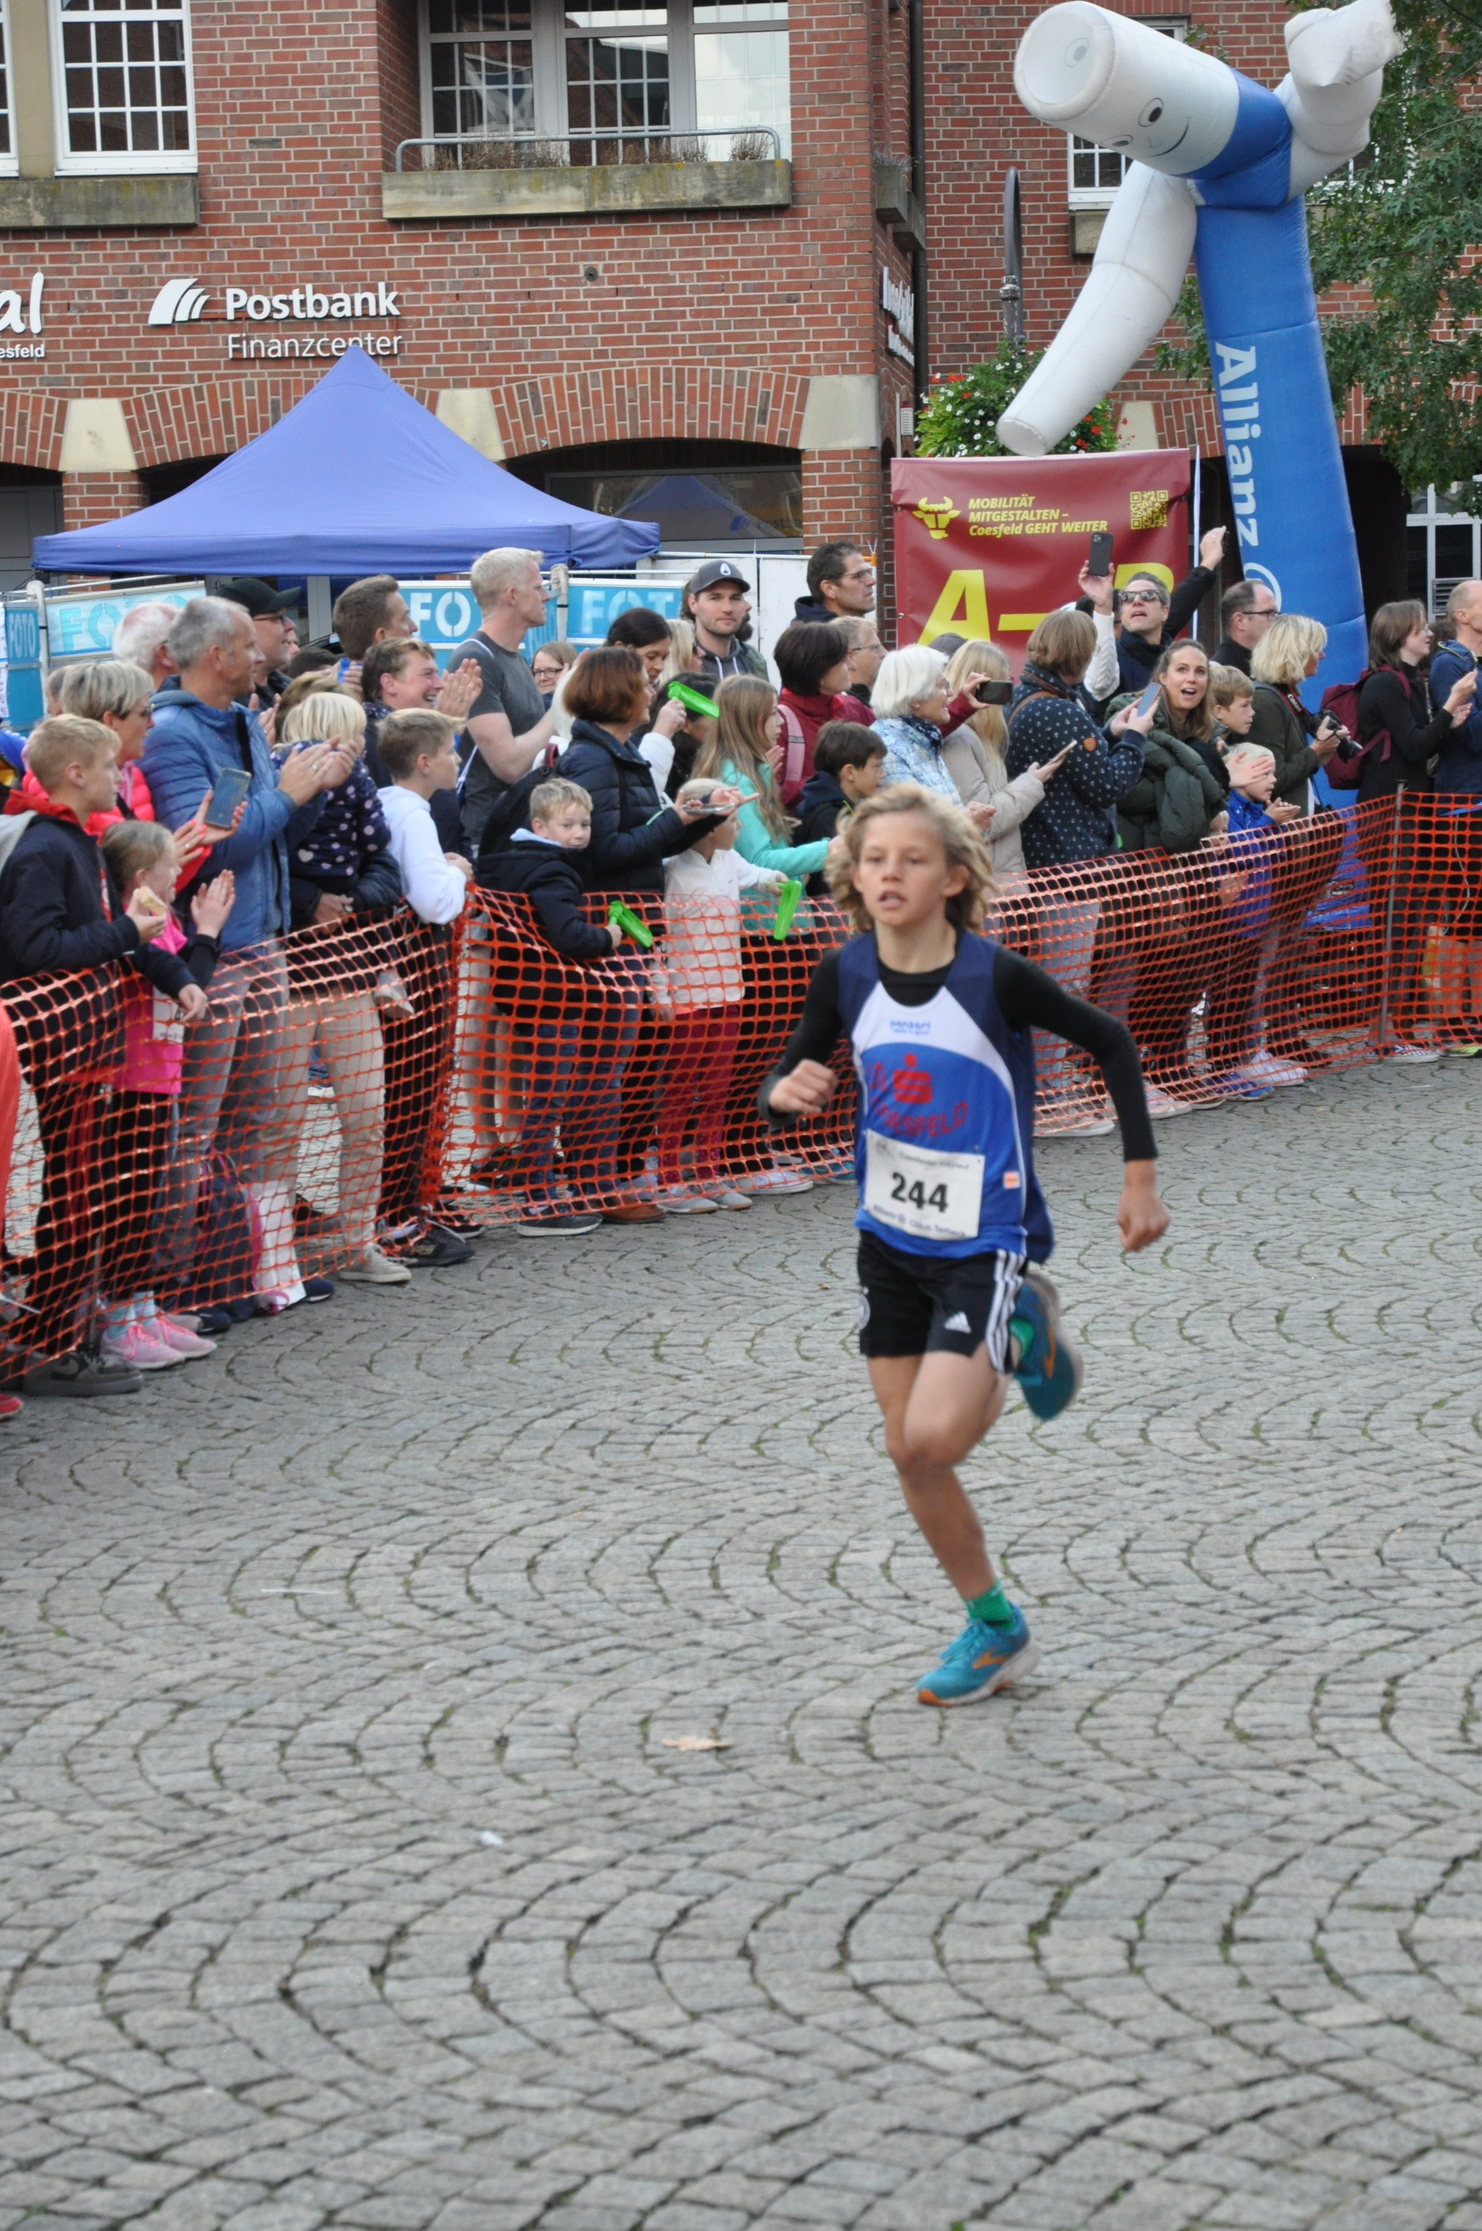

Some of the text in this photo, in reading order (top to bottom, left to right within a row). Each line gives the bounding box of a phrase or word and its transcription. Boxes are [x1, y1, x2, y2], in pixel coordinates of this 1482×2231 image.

[226, 281, 401, 320] Postbank
[227, 333, 403, 359] Finanzcenter
[1215, 341, 1262, 548] Allianz
[968, 493, 1036, 509] MOBILITÄT
[968, 509, 1060, 522] MITGESTALTEN
[969, 520, 1108, 538] Coesfeld GEHT WEITER
[9, 613, 36, 659] FOTO
[890, 1171, 949, 1214] 244
